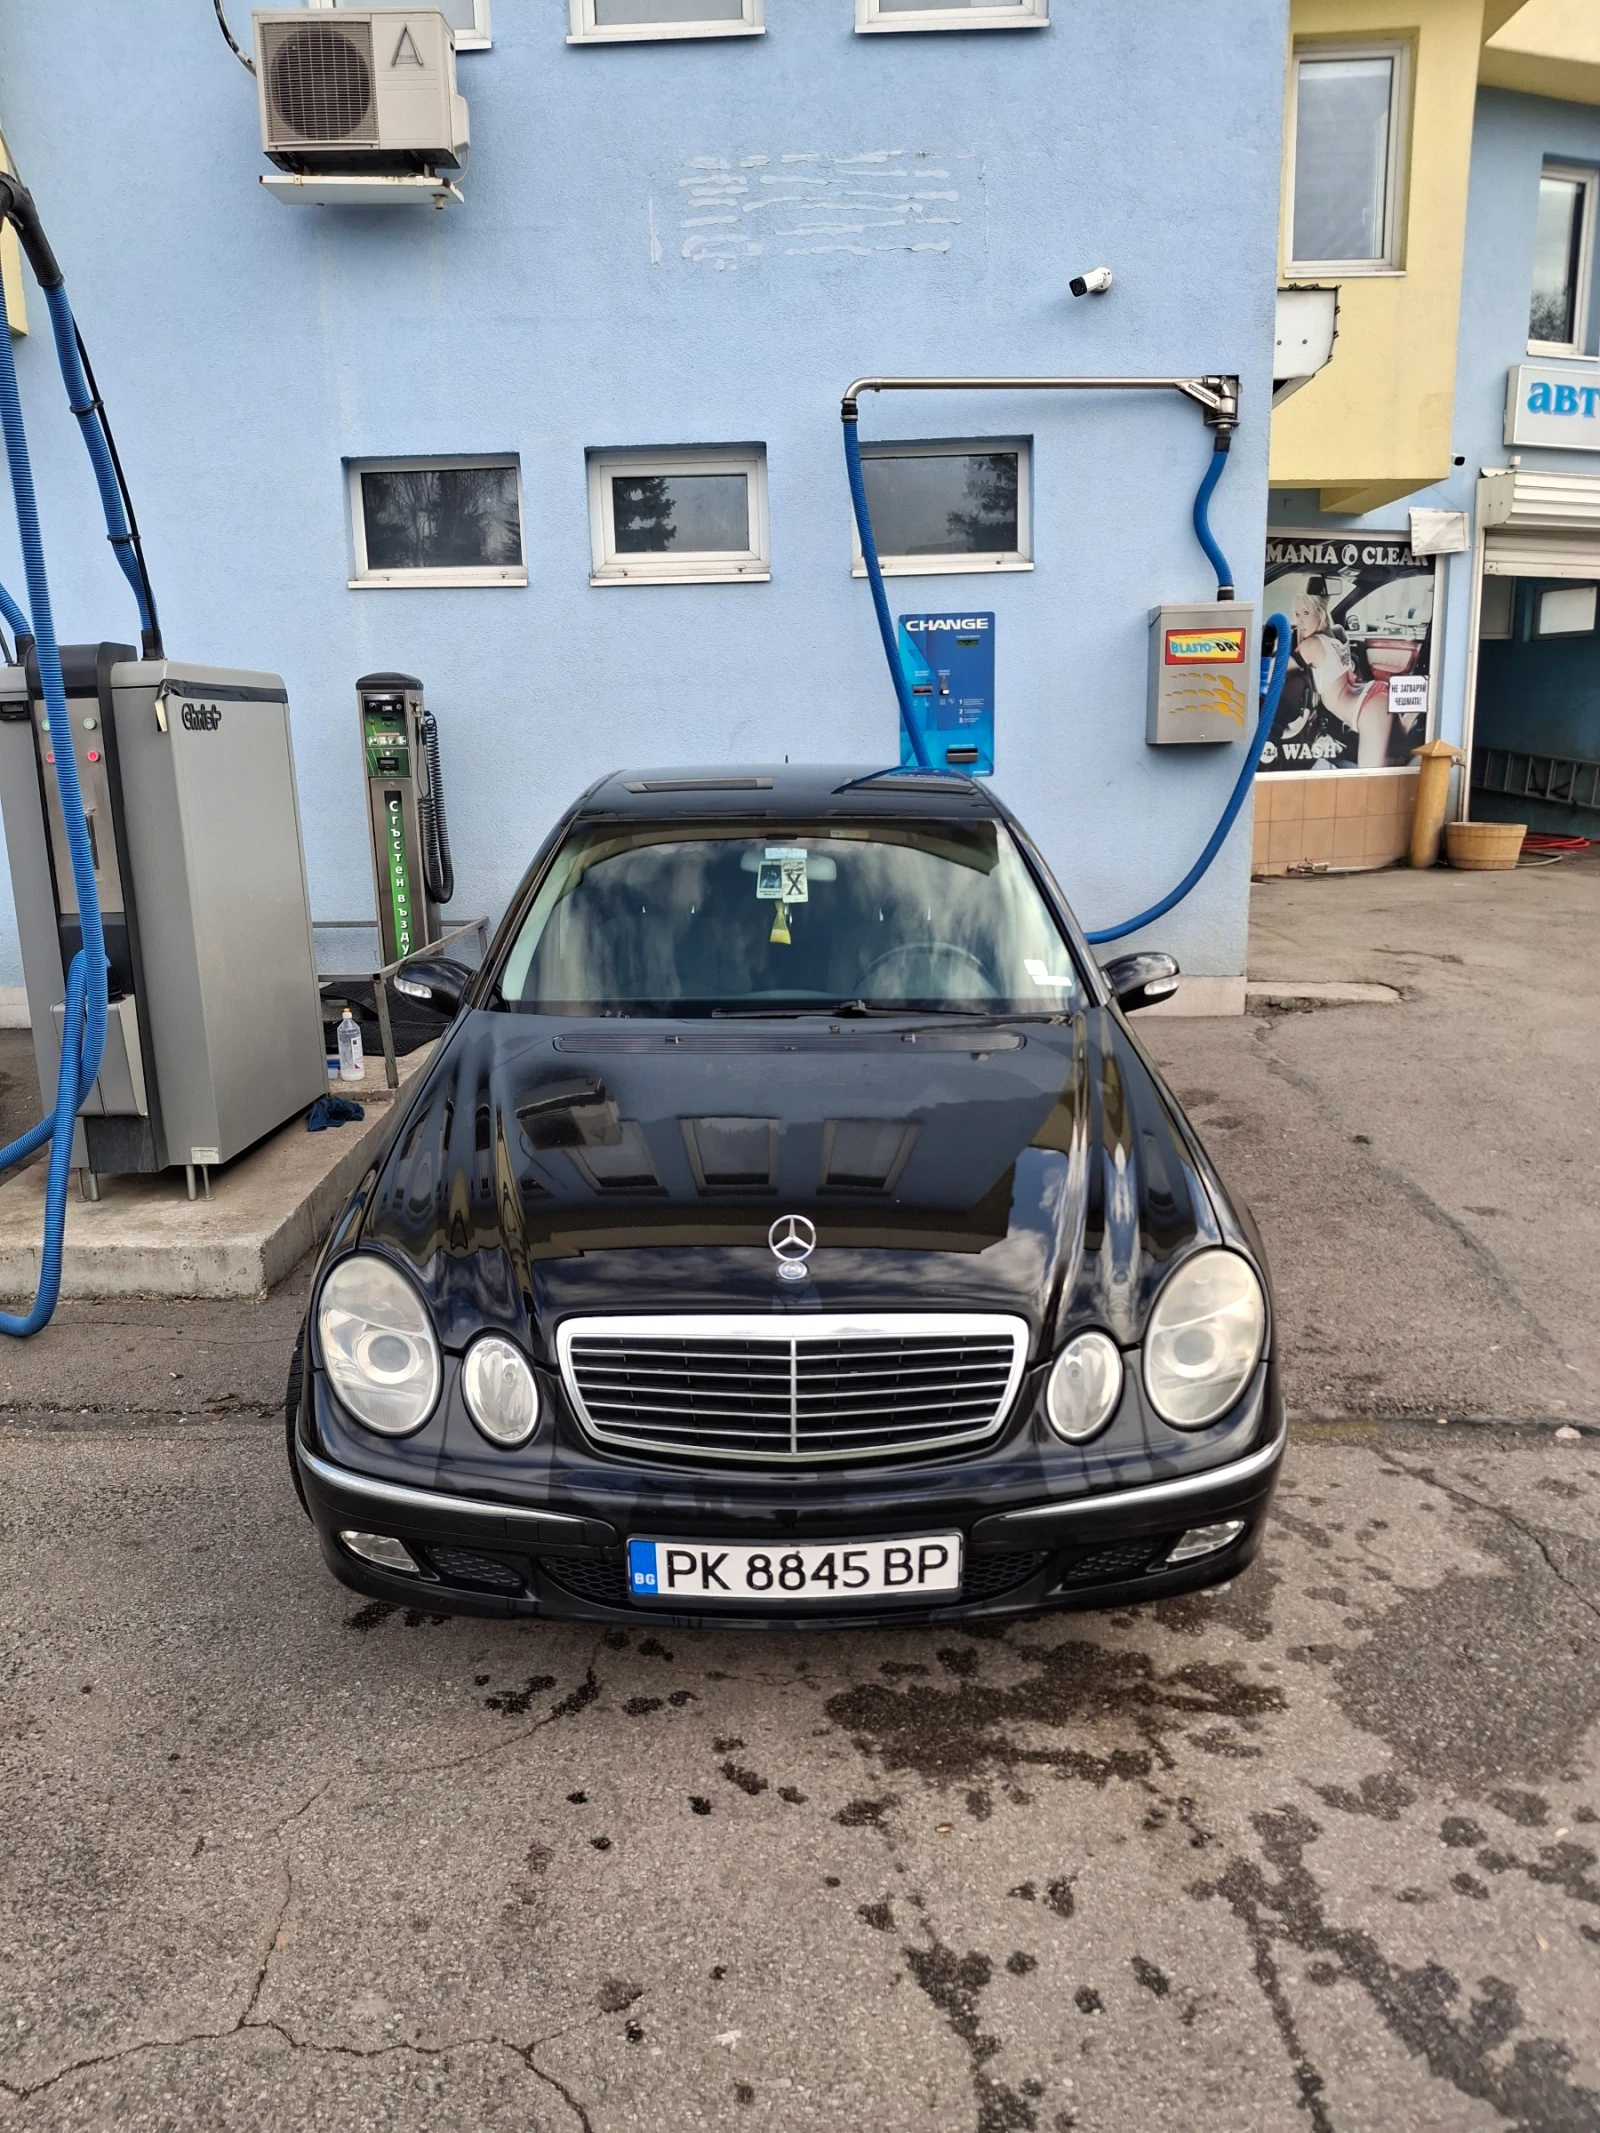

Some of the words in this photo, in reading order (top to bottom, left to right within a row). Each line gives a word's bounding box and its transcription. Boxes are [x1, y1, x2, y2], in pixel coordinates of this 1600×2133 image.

[1266, 544, 1339, 565] MANIA
[905, 618, 989, 631] CHANGE
[1170, 641, 1242, 653] BLASTO-DRY
[1391, 684, 1399, 693] НЕ
[1400, 682, 1427, 693] ЗАТВАРЯЙ
[1395, 697, 1422, 706] ЧЕШМАТА!
[181, 702, 222, 731] Christ
[1281, 743, 1337, 760] WASH
[389, 800, 406, 888] Сгъстен
[785, 872, 806, 896] X
[397, 894, 411, 958] възду
[665, 1549, 732, 1590] PK
[745, 1549, 870, 1591] 8845
[883, 1543, 949, 1587] BP
[634, 1572, 656, 1586] BG
